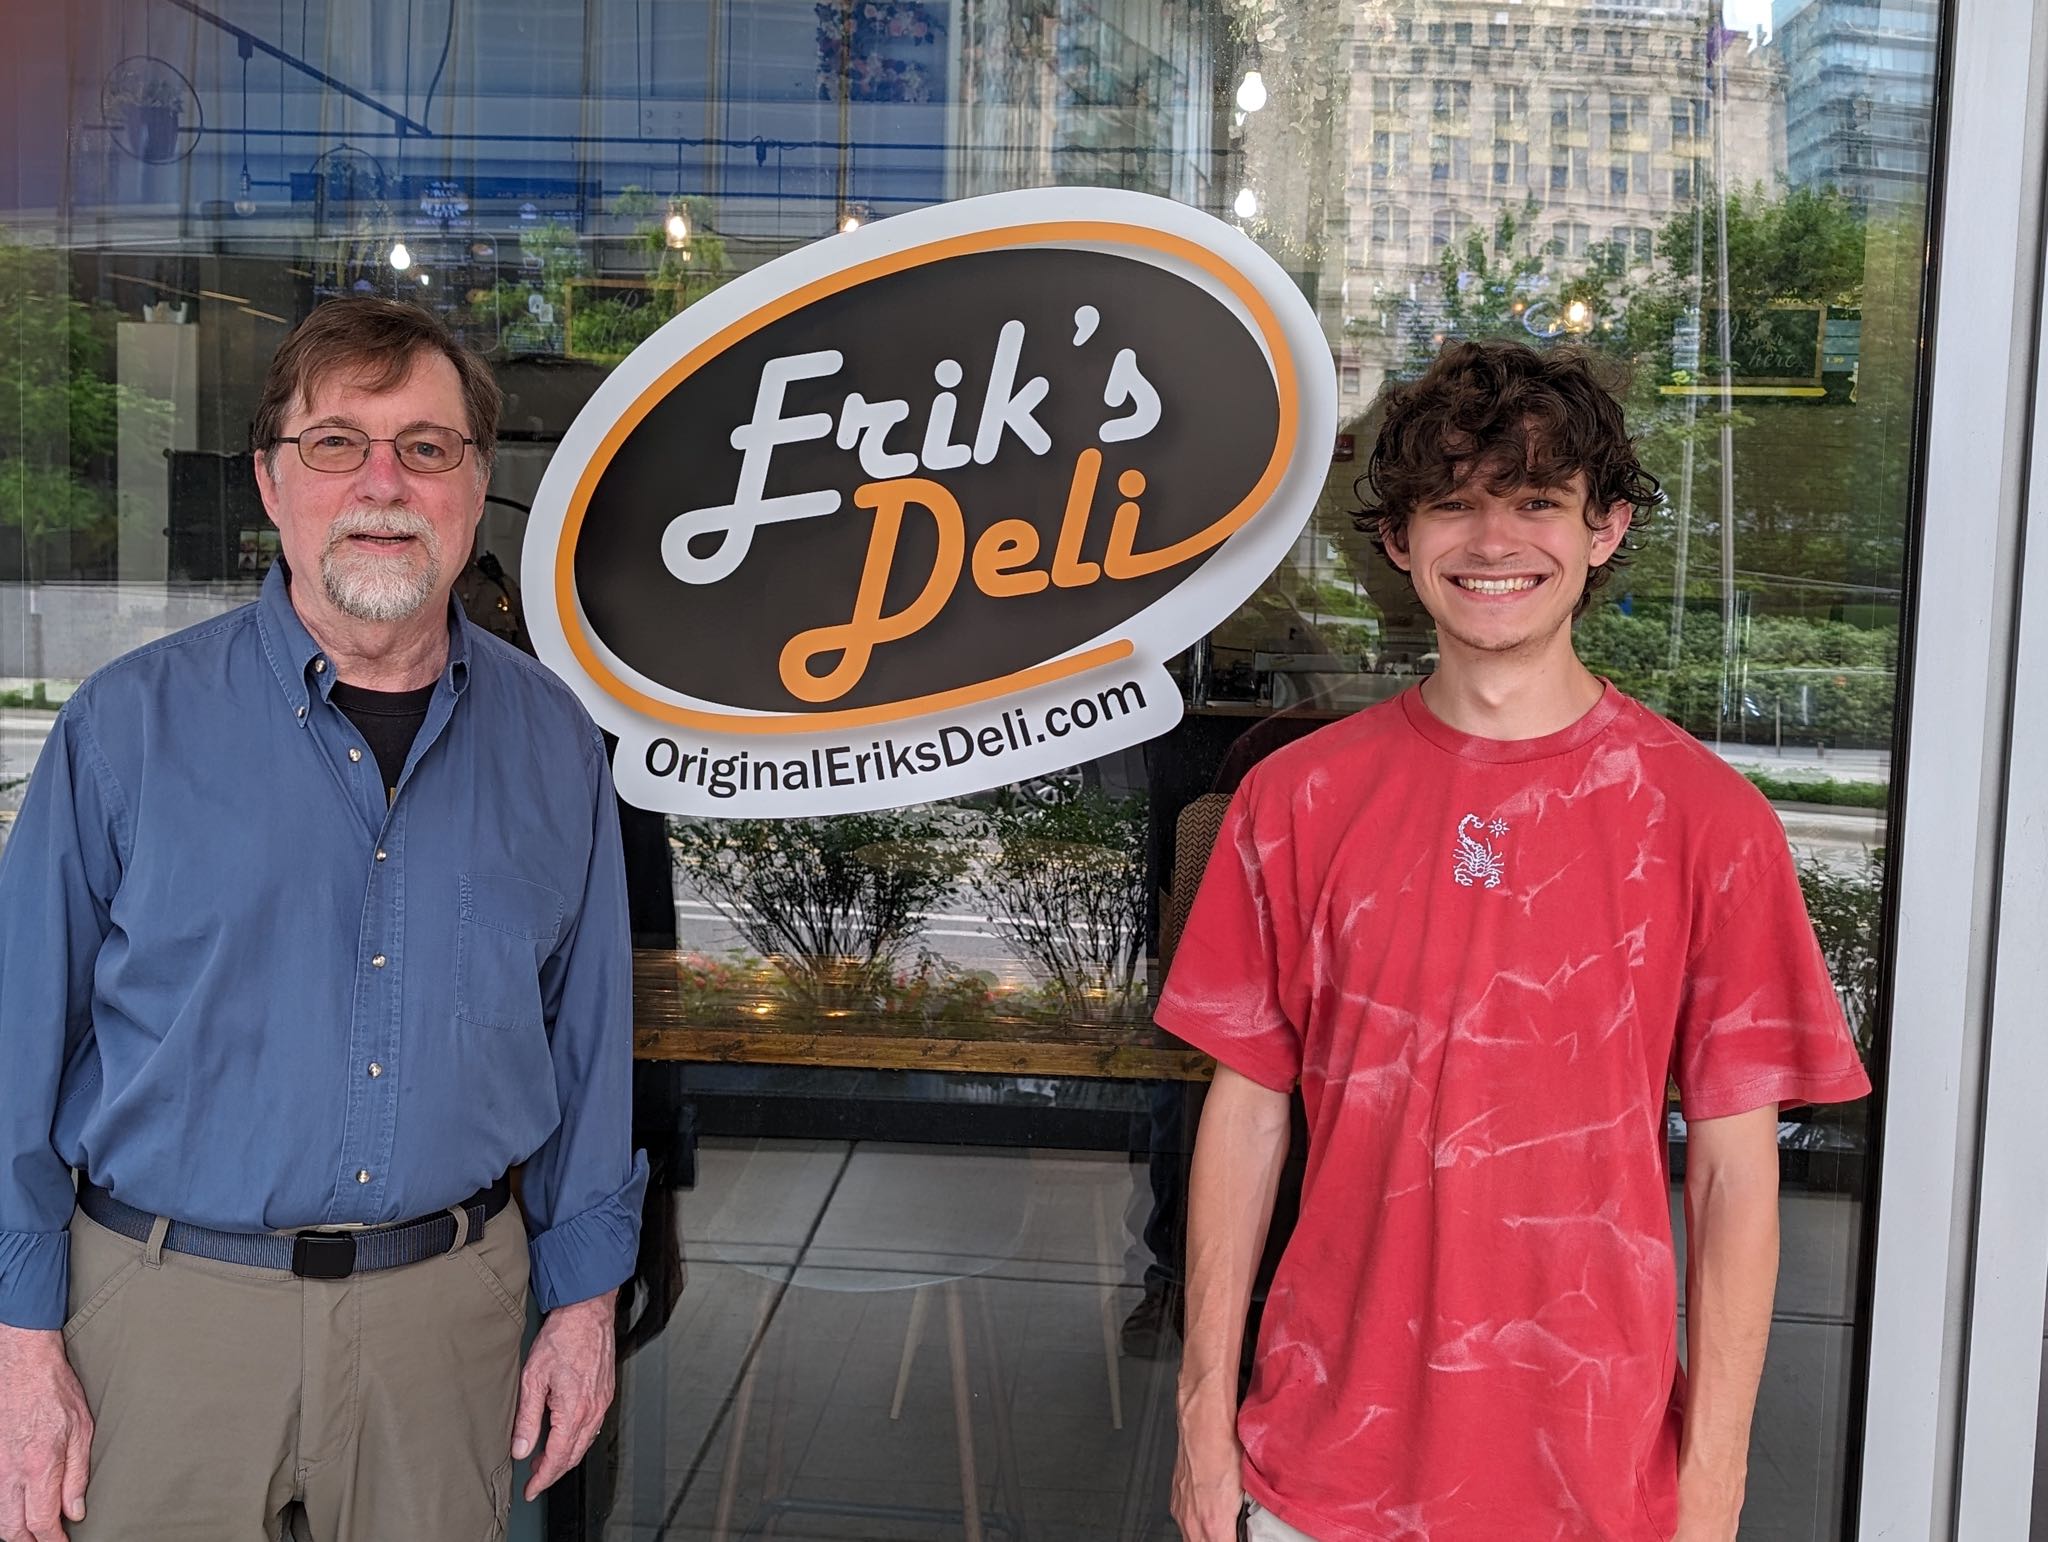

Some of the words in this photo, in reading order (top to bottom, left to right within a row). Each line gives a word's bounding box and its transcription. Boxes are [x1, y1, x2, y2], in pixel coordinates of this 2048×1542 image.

[661, 306, 1161, 584] Erik's
[779, 448, 1152, 703] Deli
[645, 676, 1147, 799] OriginalEriksDeli.com
